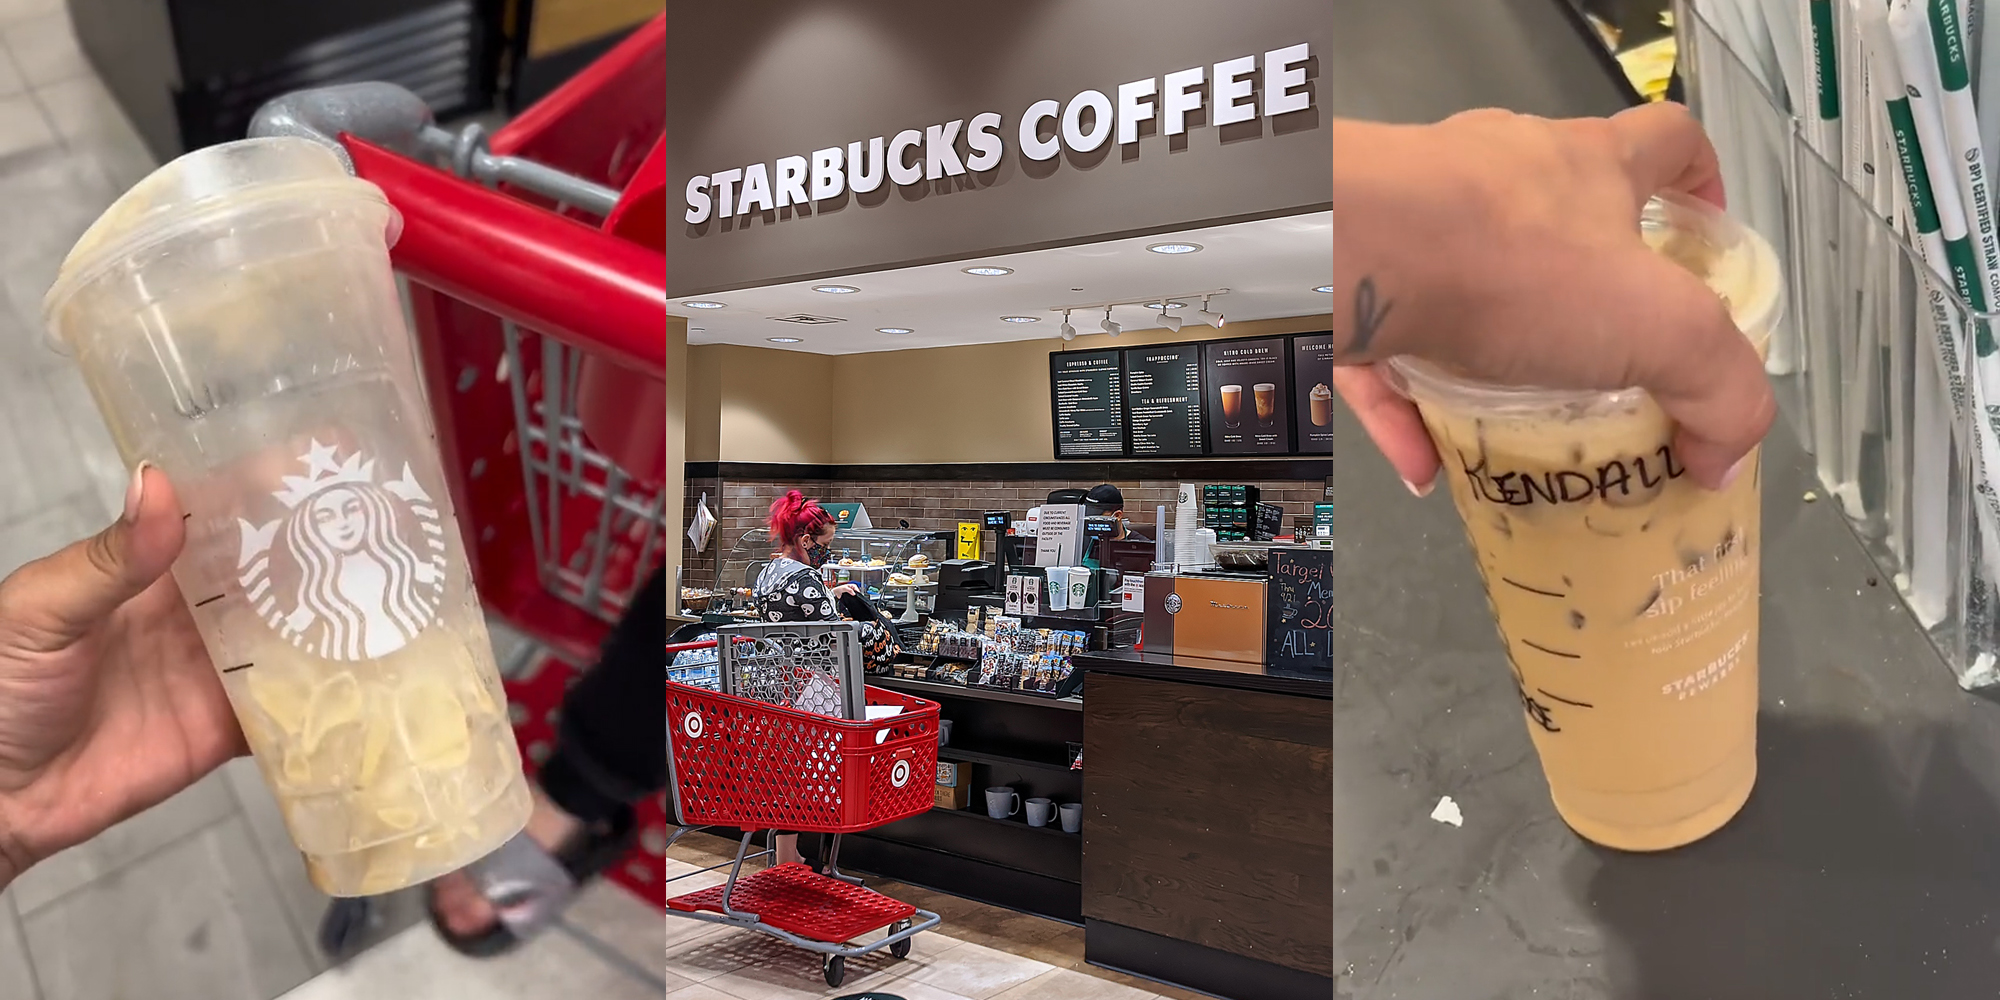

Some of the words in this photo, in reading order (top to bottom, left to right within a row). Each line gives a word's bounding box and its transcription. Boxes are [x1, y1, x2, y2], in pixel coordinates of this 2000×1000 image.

[685, 112, 1003, 225] STARBUCKS
[1018, 42, 1311, 162] COFFEE
[1969, 161, 1983, 182] BPI
[1972, 182, 1992, 235] CERTIFIED
[1982, 235, 1999, 271] STRAW
[1458, 443, 1686, 507] KENDALL
[1272, 551, 1324, 585] Target
[1652, 556, 1705, 591] That
[1713, 526, 1745, 560] first
[1644, 596, 1683, 620] sip
[1280, 629, 1315, 659] ALL
[1662, 629, 1750, 695] STARBUCKS
